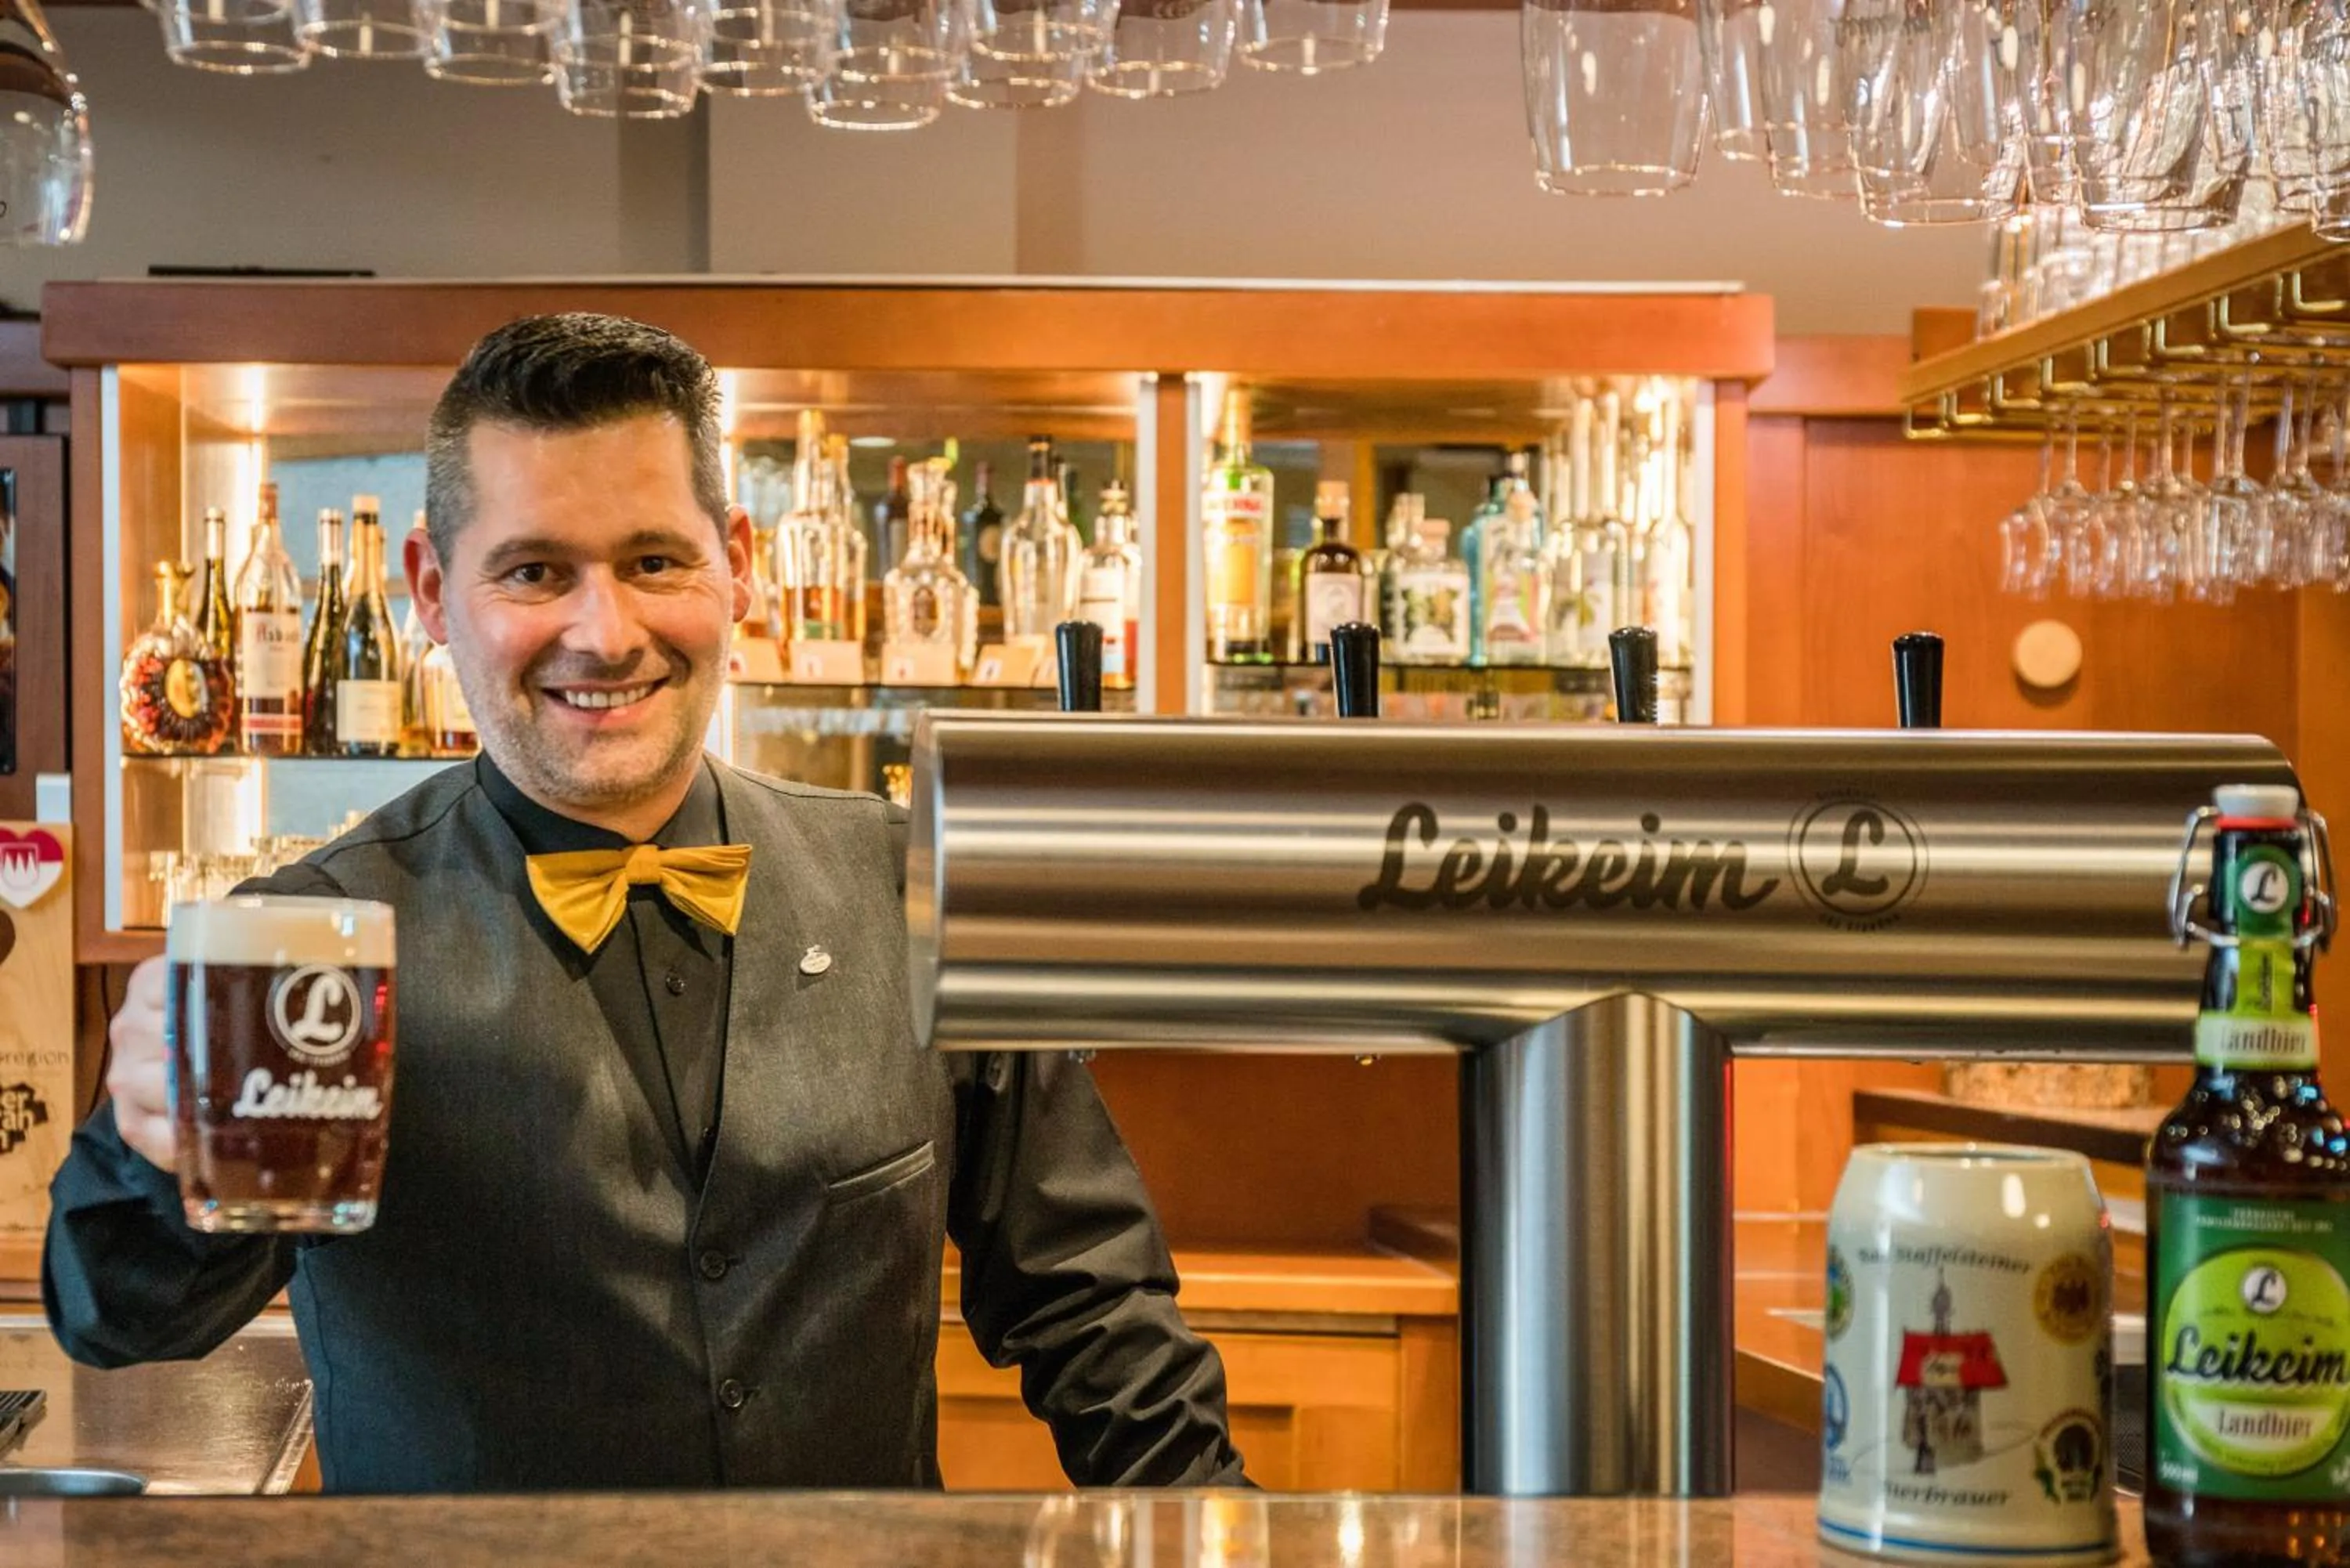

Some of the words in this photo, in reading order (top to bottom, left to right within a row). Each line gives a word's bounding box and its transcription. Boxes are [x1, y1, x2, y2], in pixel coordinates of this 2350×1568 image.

[1357, 801, 1781, 912] Leikeim
[1821, 808, 1889, 897] L
[291, 974, 344, 1041] L
[0, 1051, 70, 1066] region
[231, 1067, 384, 1120] Leikeim
[2167, 1325, 2348, 1385] Leikeim
[2218, 1407, 2313, 1439] Landbier
